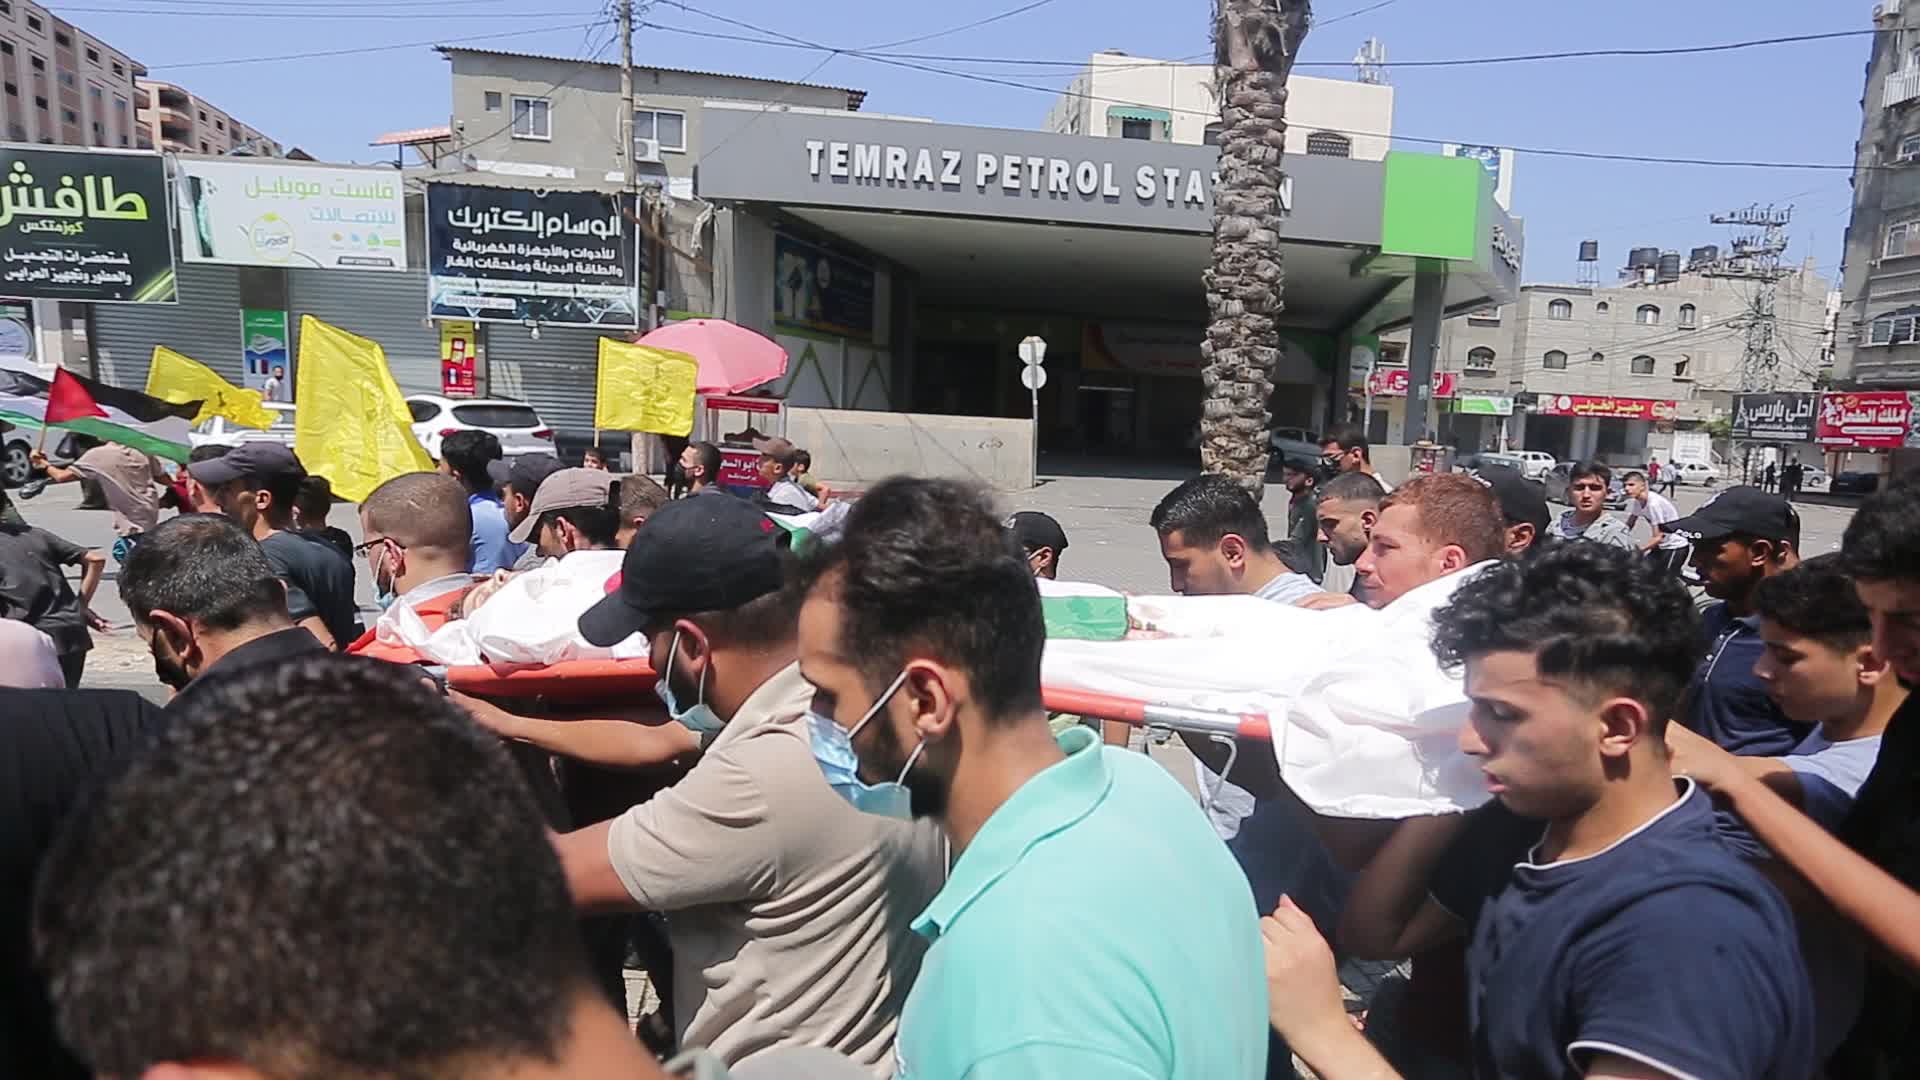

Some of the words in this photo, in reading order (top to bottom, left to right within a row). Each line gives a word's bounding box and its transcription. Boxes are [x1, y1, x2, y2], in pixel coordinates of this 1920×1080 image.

[806, 140, 961, 185] TEMRAZ
[976, 152, 1120, 197] PETROL
[1135, 166, 1293, 211] STAN
[0, 161, 148, 228] طافش
[245, 176, 320, 200] موبايل
[329, 178, 395, 200] فاست
[19, 219, 84, 235] كوزمتكس
[448, 206, 544, 238] إلكتريك
[546, 211, 621, 240] الوسام
[4, 247, 63, 264] التجميل
[518, 242, 569, 259] والأجهزة
[571, 246, 615, 260] للأدوات
[475, 257, 531, 274] وملحقات
[533, 259, 574, 274] البديلة
[575, 261, 623, 277] والطاقة
